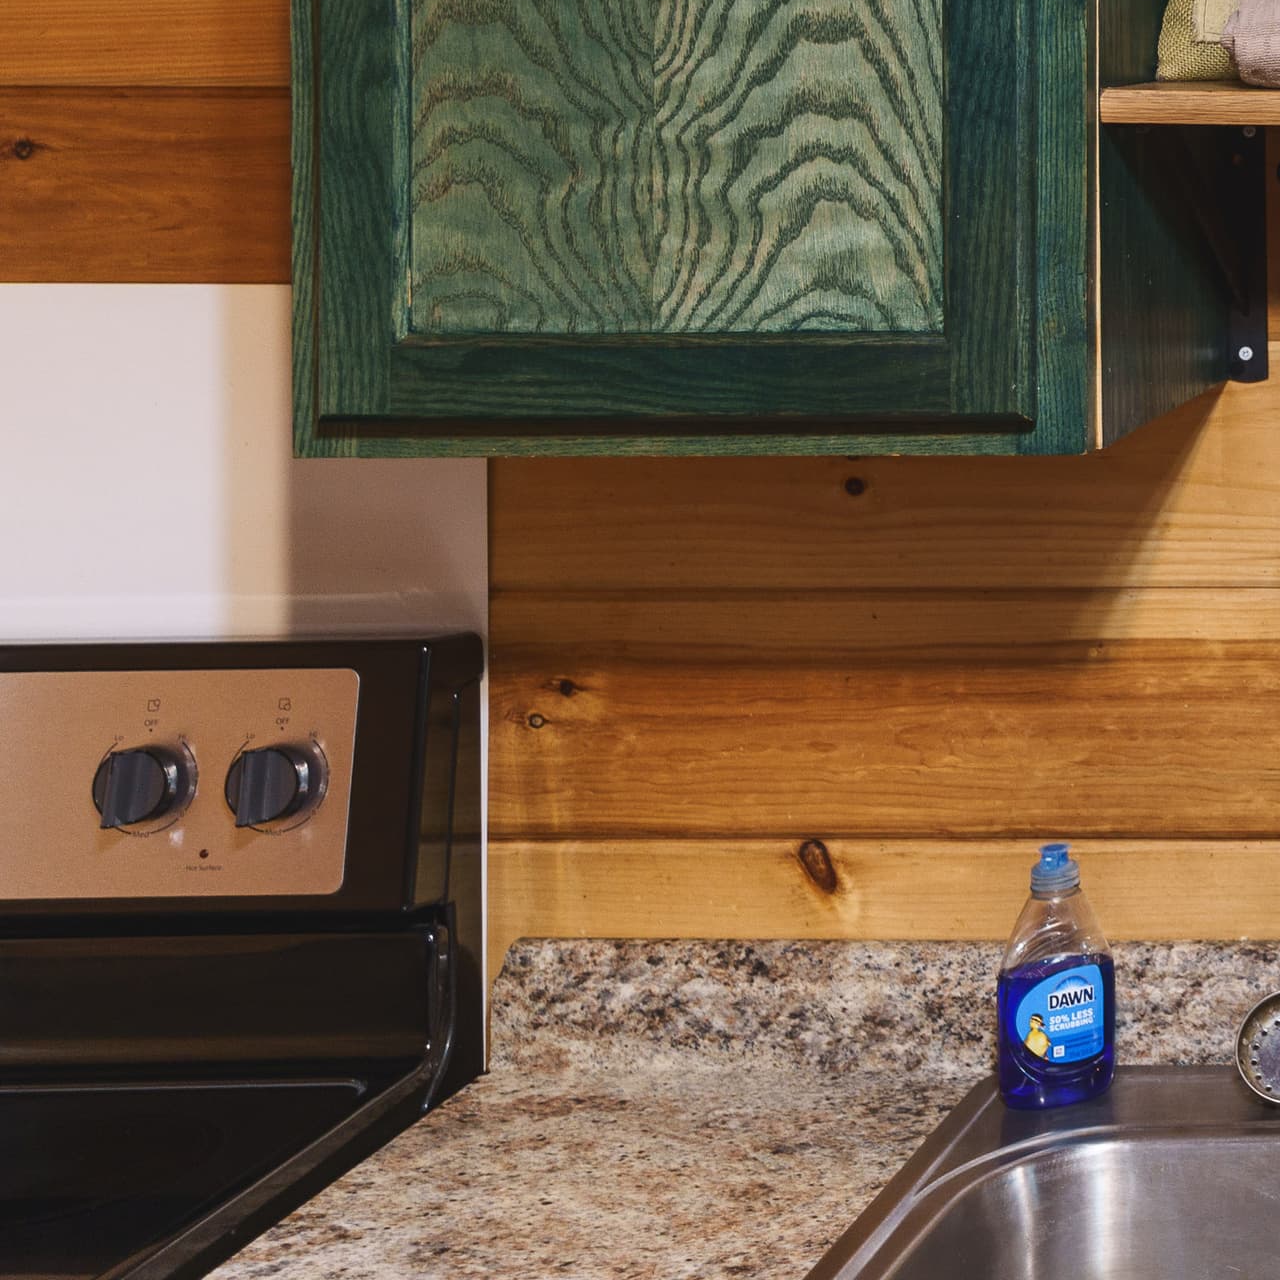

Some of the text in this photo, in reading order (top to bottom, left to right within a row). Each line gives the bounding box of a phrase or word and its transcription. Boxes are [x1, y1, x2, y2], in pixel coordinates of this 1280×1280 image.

[144, 719, 158, 727] OFF
[1049, 987, 1093, 1010] DAWN
[1049, 1008, 1094, 1025] 50% LESS
[1049, 1016, 1094, 1032] SCRUBBING
